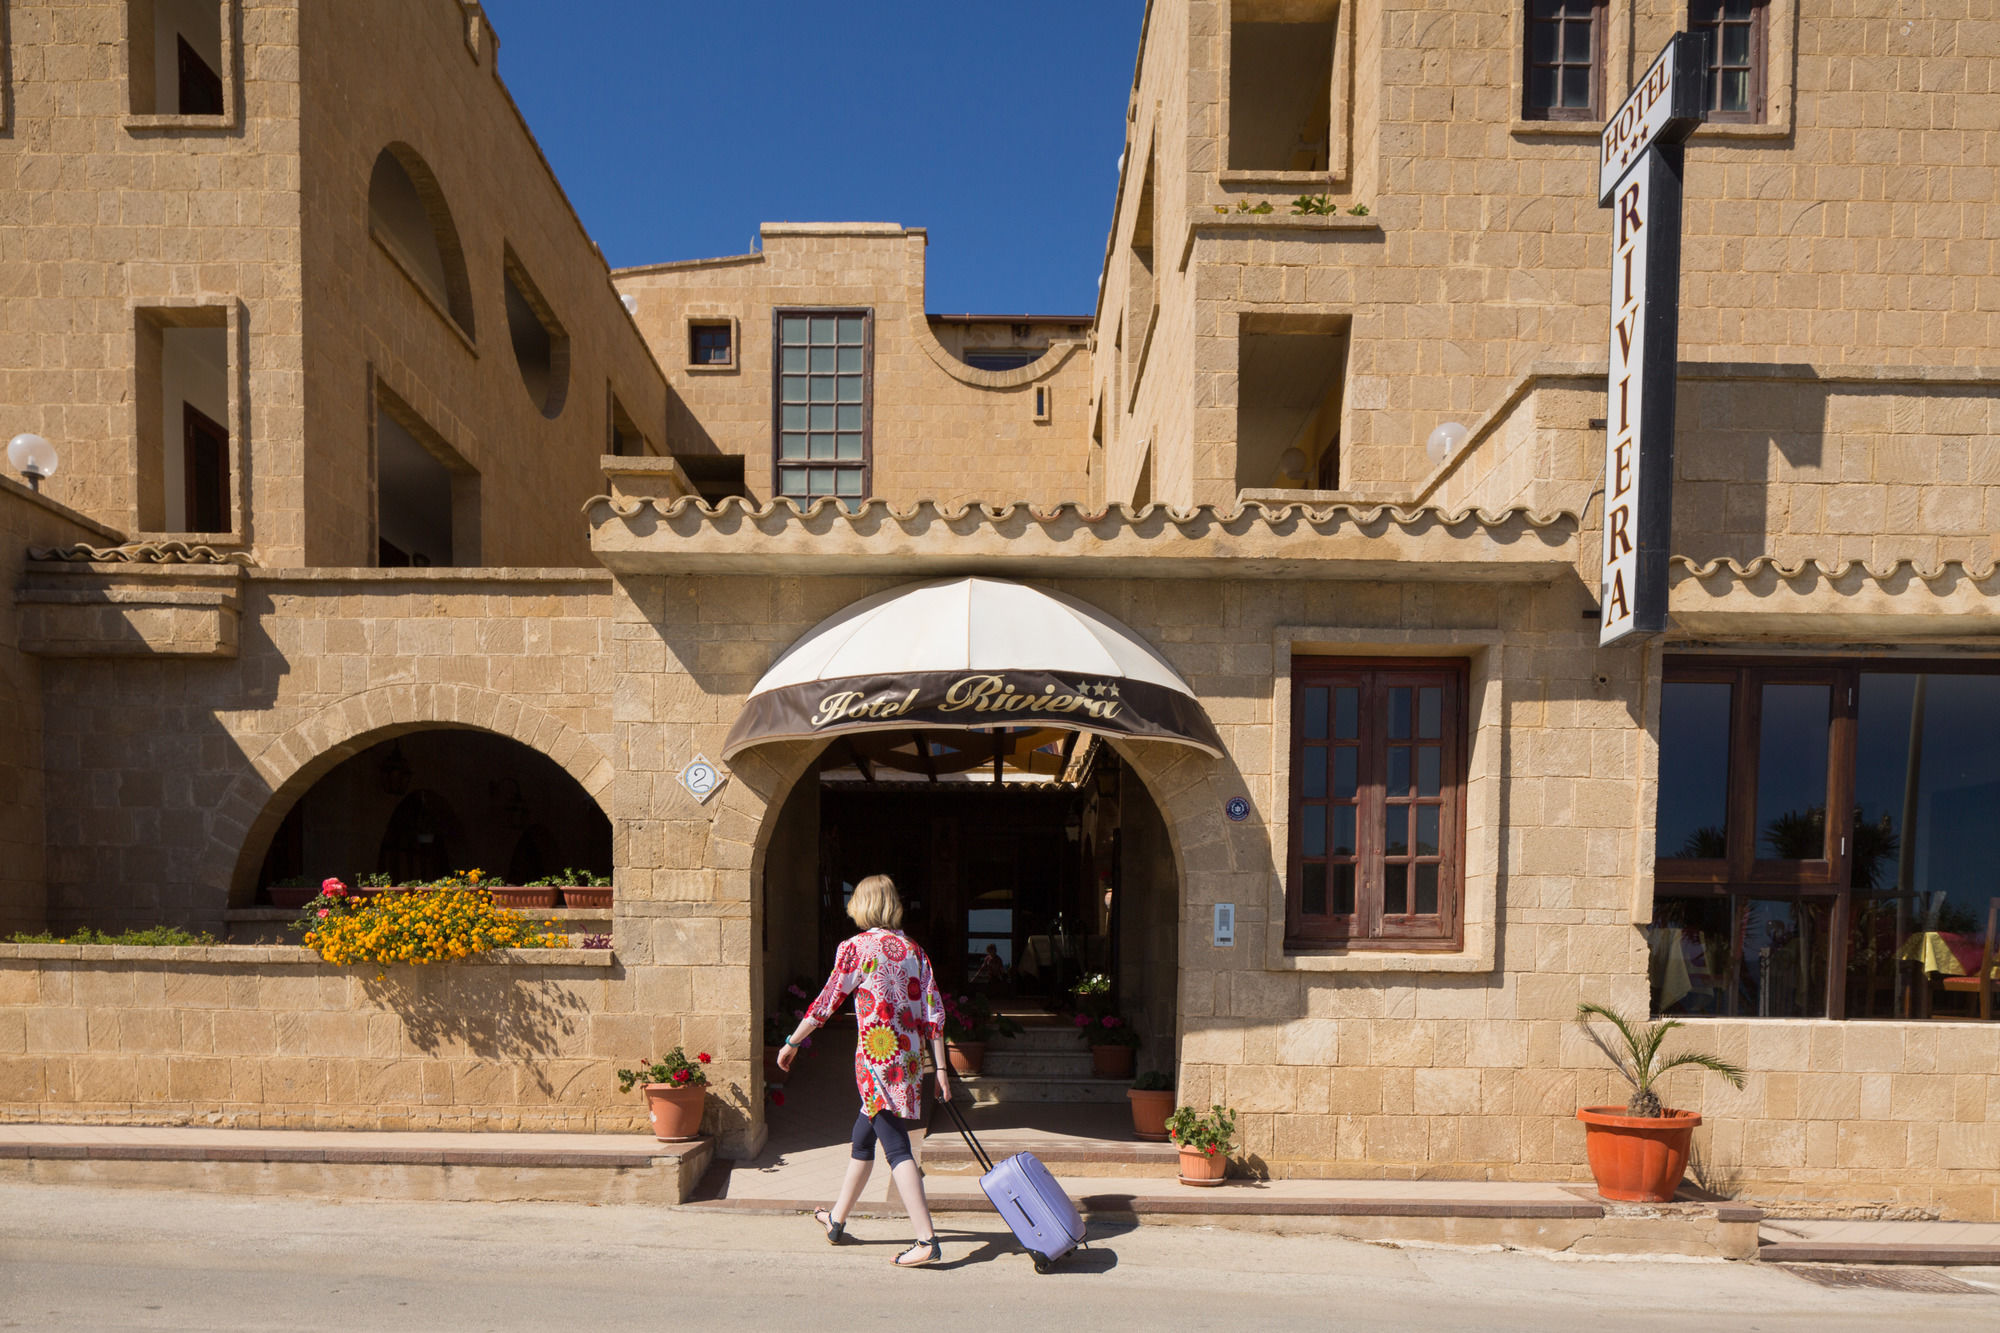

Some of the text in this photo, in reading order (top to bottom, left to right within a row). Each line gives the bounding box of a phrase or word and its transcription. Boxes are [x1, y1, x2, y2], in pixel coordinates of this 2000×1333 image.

[1604, 57, 1671, 167] HOTEL
[1605, 182, 1644, 628] RIVIERA
[811, 674, 1124, 726] Hotel Riviera
[692, 767, 710, 790] 2
